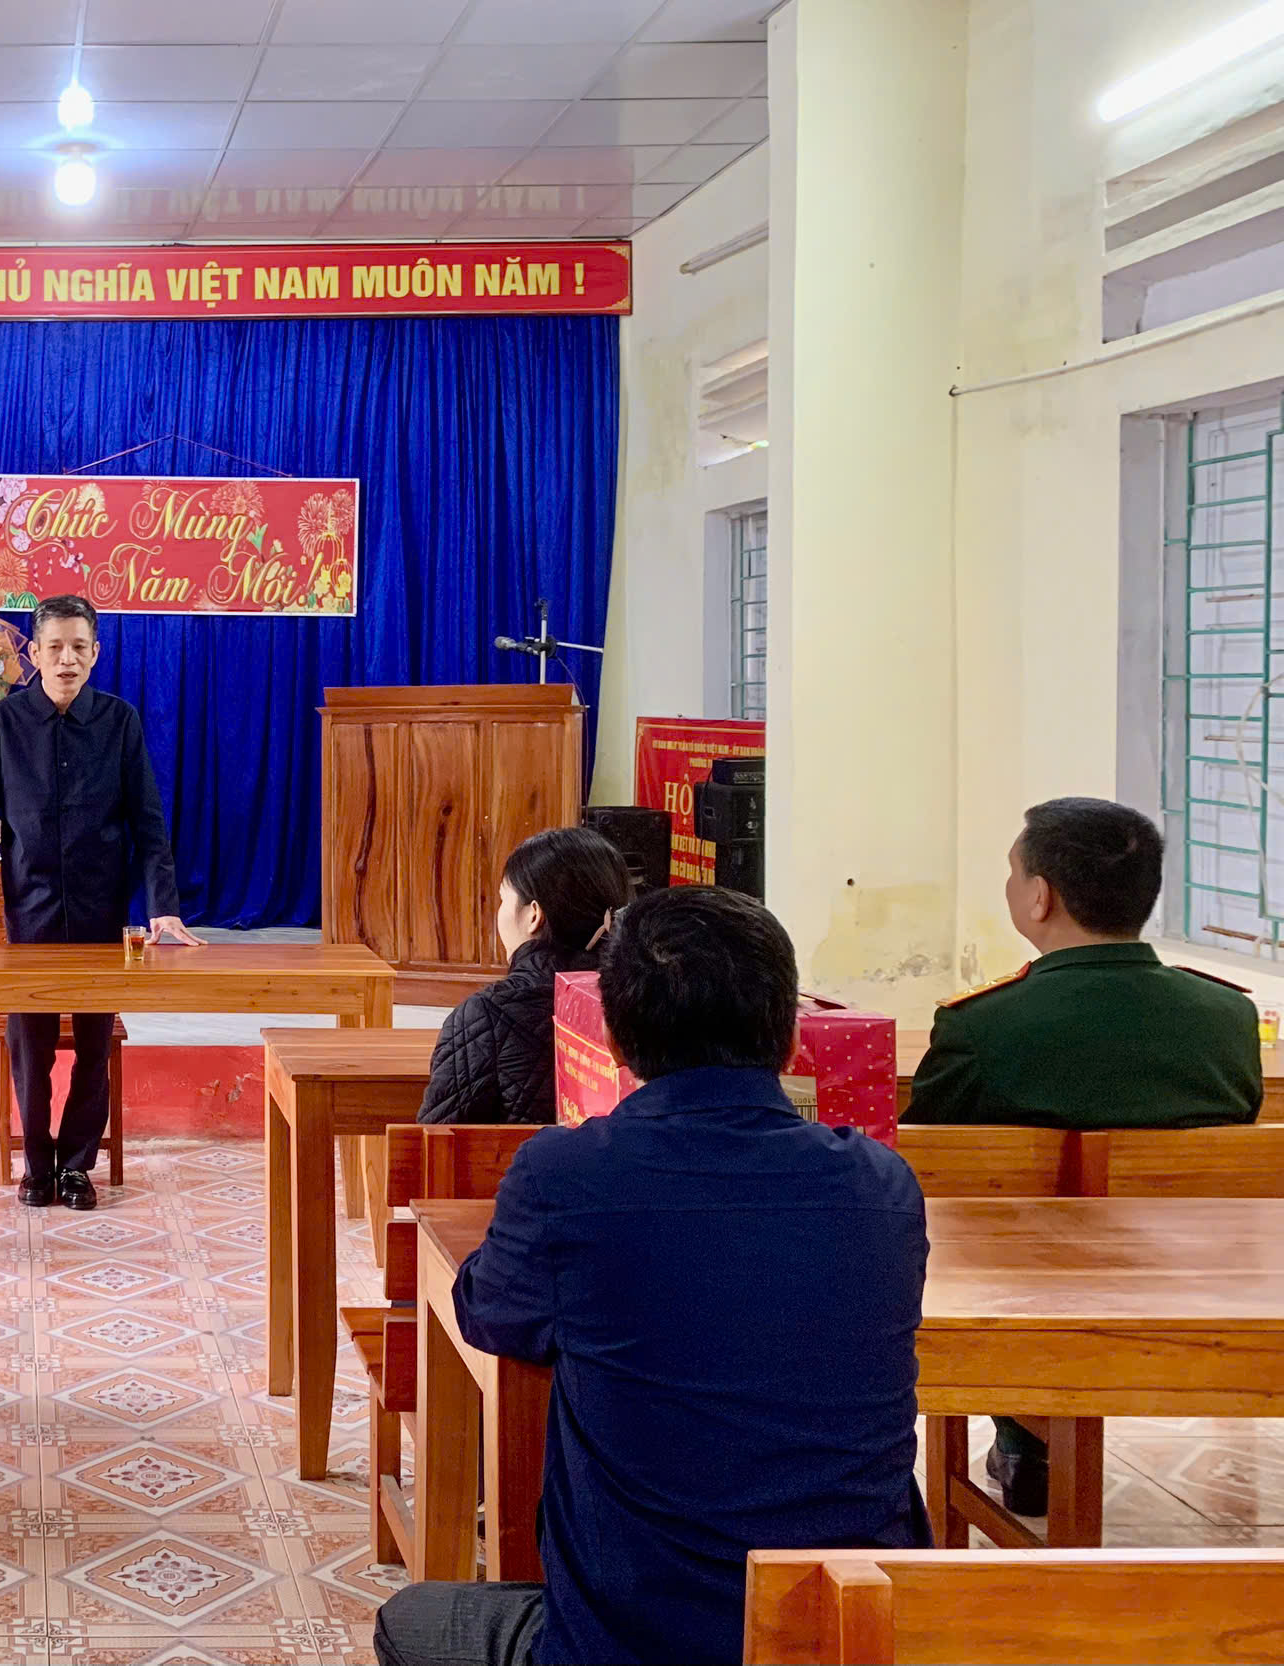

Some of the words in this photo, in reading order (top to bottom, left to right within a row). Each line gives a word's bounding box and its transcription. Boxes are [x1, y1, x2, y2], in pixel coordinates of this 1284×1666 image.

[43, 263, 156, 303] NGHĨA
[166, 261, 243, 309] VIỆT
[254, 265, 339, 300] NAM
[352, 257, 462, 298] MUÔN
[474, 256, 560, 297] NĂM
[574, 262, 585, 295] !
[5, 487, 118, 561] Chúc
[88, 543, 196, 607] Năm
[664, 772, 694, 826] HỘ
